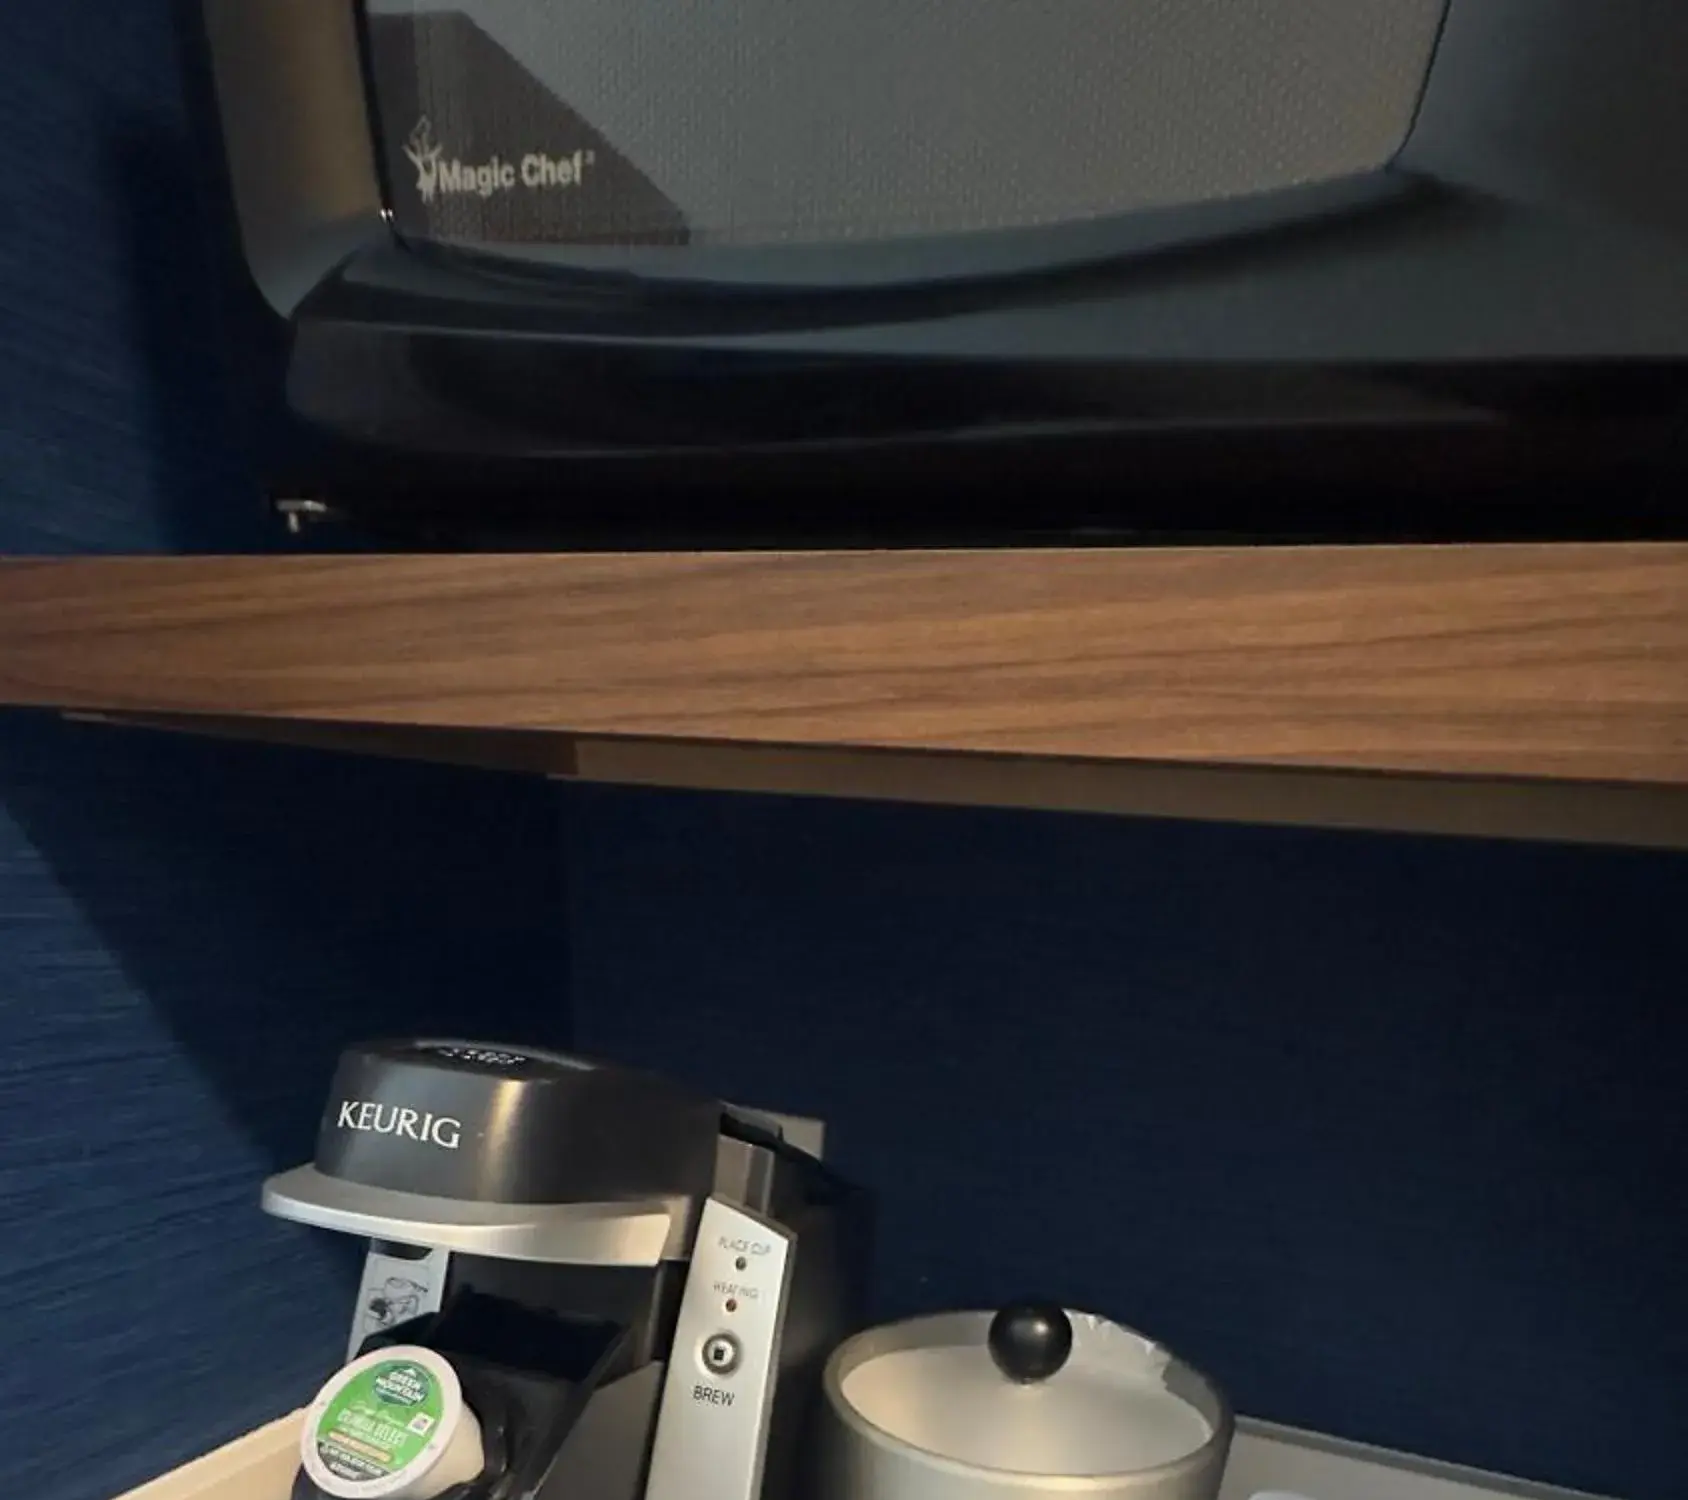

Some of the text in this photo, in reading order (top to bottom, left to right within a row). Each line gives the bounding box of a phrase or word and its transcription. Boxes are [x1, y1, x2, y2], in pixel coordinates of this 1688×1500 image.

[438, 150, 584, 197] Magic Chef
[337, 1101, 461, 1149] KEURIG
[713, 1281, 758, 1299] HEATING
[693, 1386, 735, 1407] BREW
